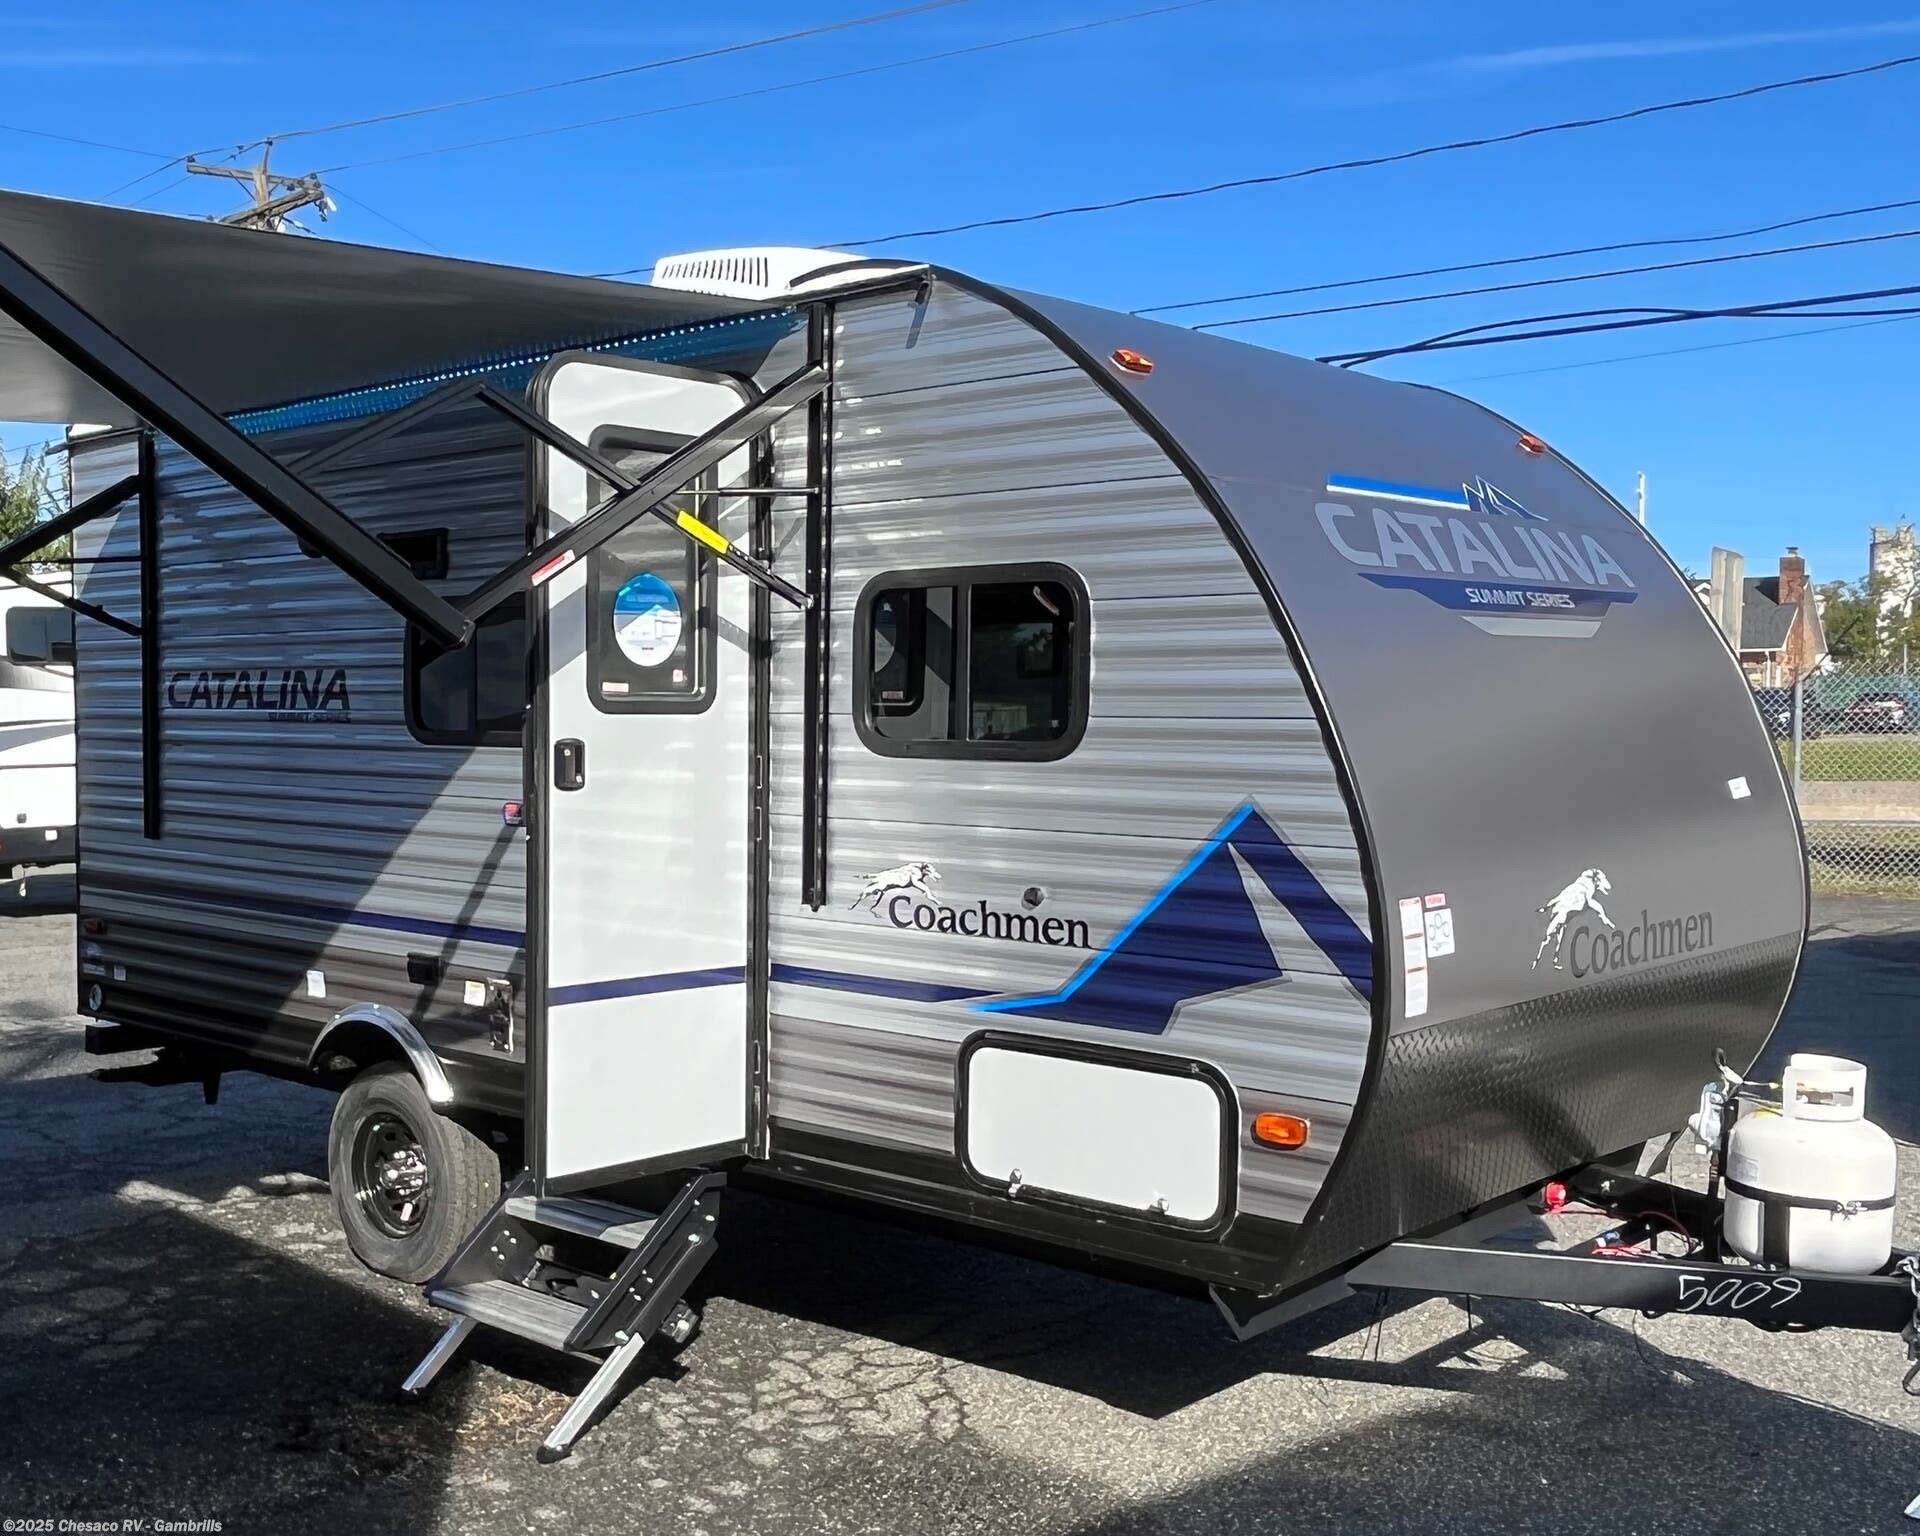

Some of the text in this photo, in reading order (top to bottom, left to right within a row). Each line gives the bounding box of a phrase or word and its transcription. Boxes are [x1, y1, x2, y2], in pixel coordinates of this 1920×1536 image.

[1314, 502, 1635, 587] CATALINA
[1465, 588, 1576, 608] SUMMIT SERIES
[168, 669, 351, 710] CATALINA
[888, 894, 1094, 950] Coachmen
[1569, 908, 1714, 979] Coachmen
[1676, 1274, 1802, 1313] 5009
